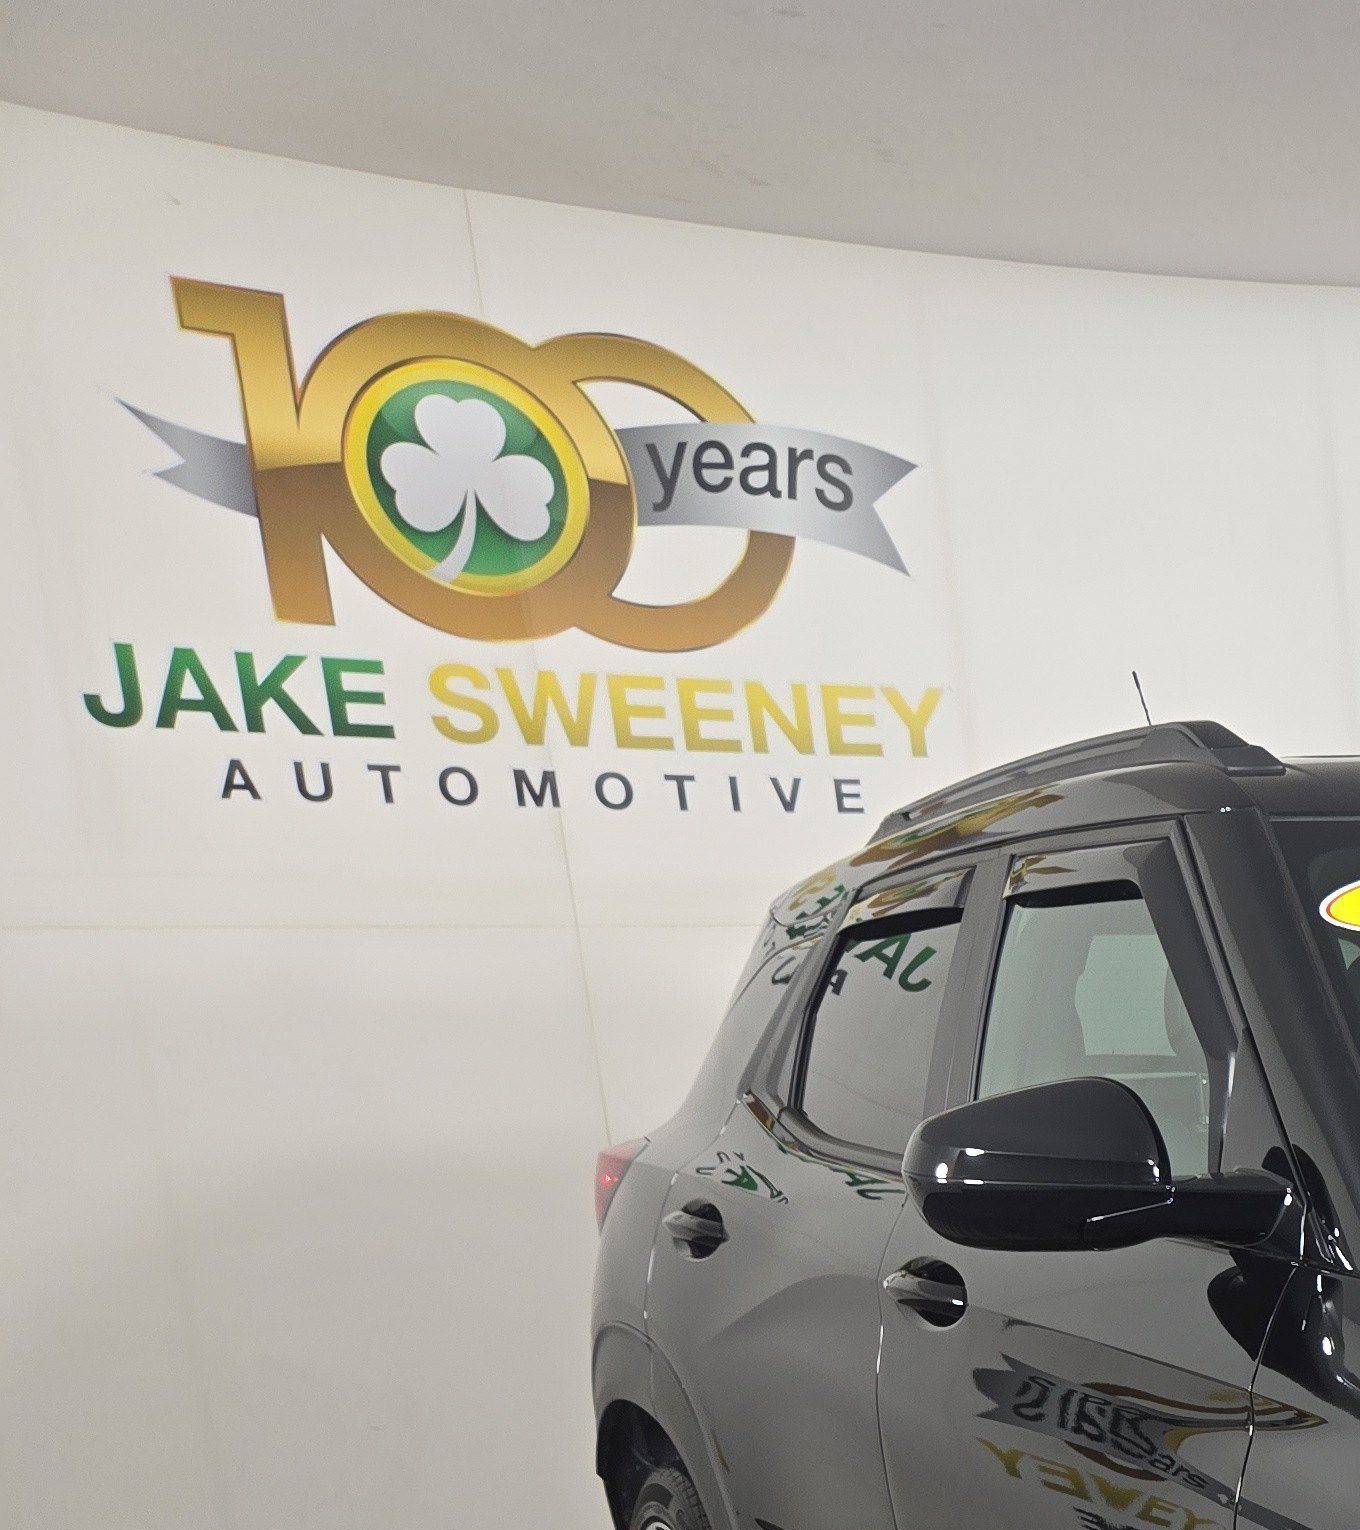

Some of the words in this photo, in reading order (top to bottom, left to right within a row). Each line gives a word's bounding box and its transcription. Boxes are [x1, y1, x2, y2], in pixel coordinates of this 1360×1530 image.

[170, 275, 796, 652] 100
[645, 437, 855, 514] years
[83, 641, 397, 740] JAKE
[428, 662, 944, 759] SWEENEY
[221, 758, 866, 815] AUTOMOTIVE
